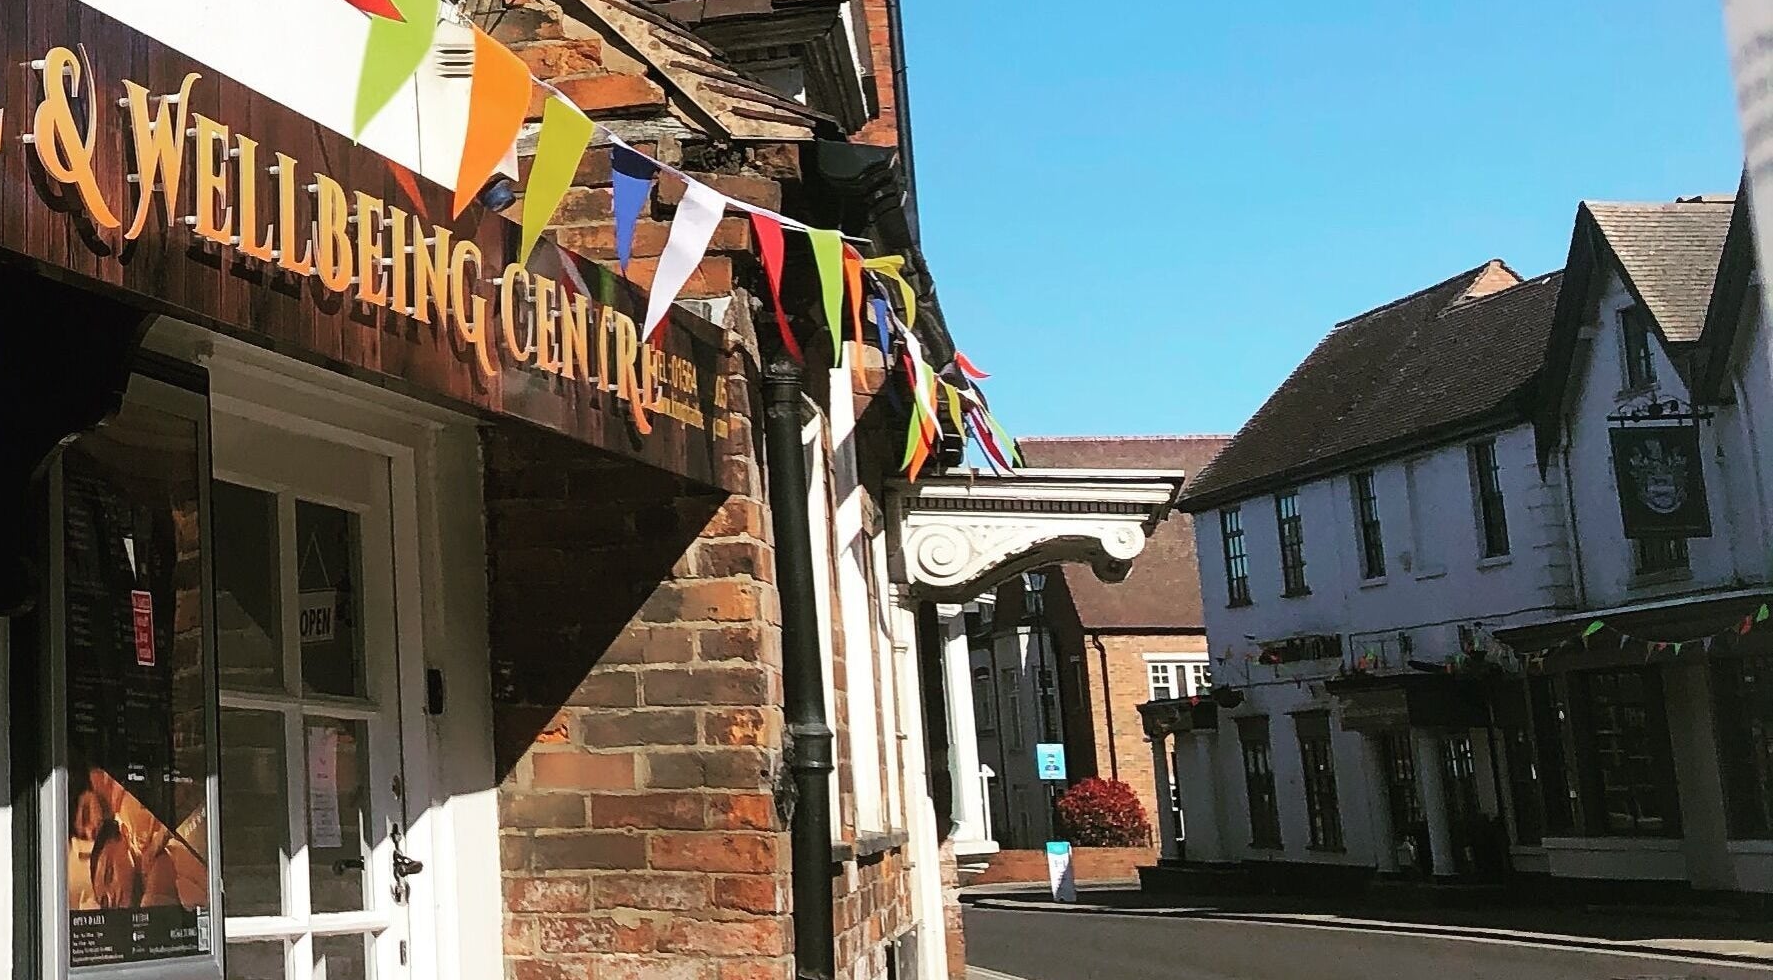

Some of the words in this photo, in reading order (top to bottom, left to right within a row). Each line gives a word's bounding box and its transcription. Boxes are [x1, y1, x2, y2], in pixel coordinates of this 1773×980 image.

[33, 42, 121, 229] &
[121, 72, 497, 377] WELLBEING
[500, 262, 662, 435] CENTRE
[299, 606, 332, 638] OPEN
